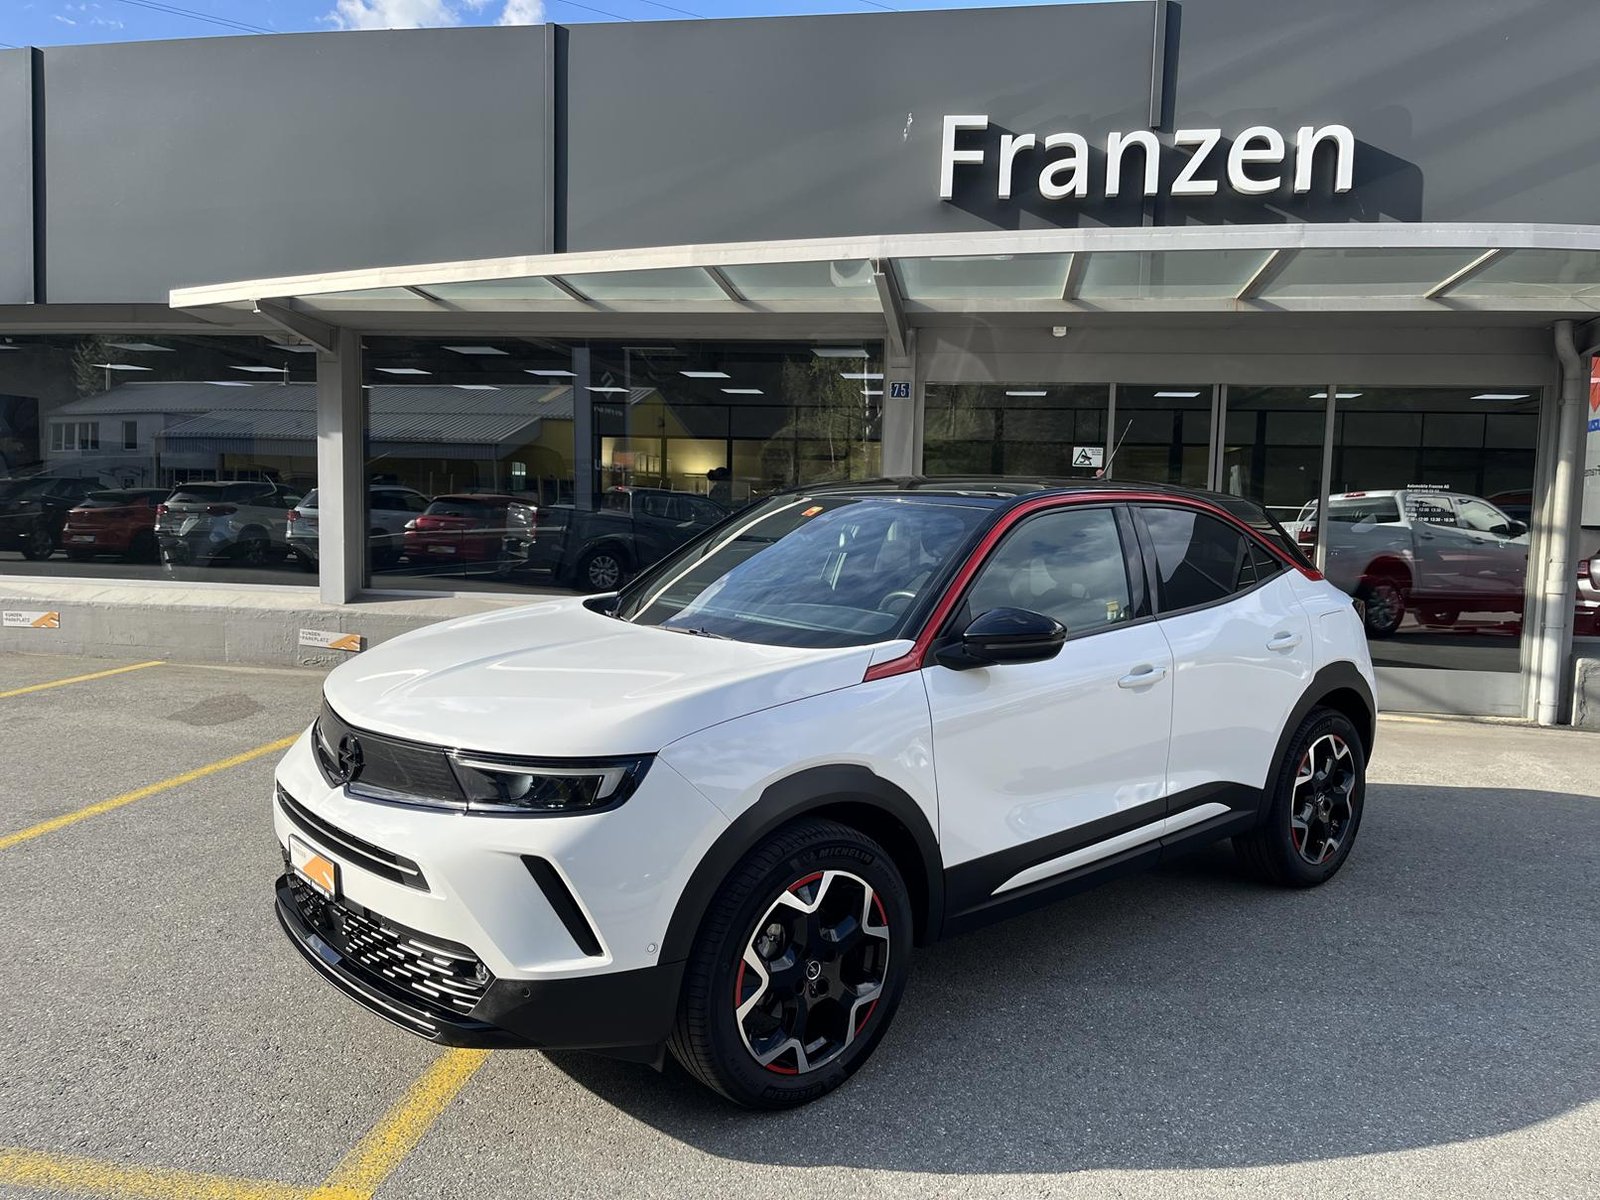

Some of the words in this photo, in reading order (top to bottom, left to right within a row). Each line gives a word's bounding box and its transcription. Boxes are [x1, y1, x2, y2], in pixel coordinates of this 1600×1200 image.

[939, 114, 1355, 200] Franzen
[893, 383, 906, 397] 75
[819, 849, 873, 863] MICHELIN
